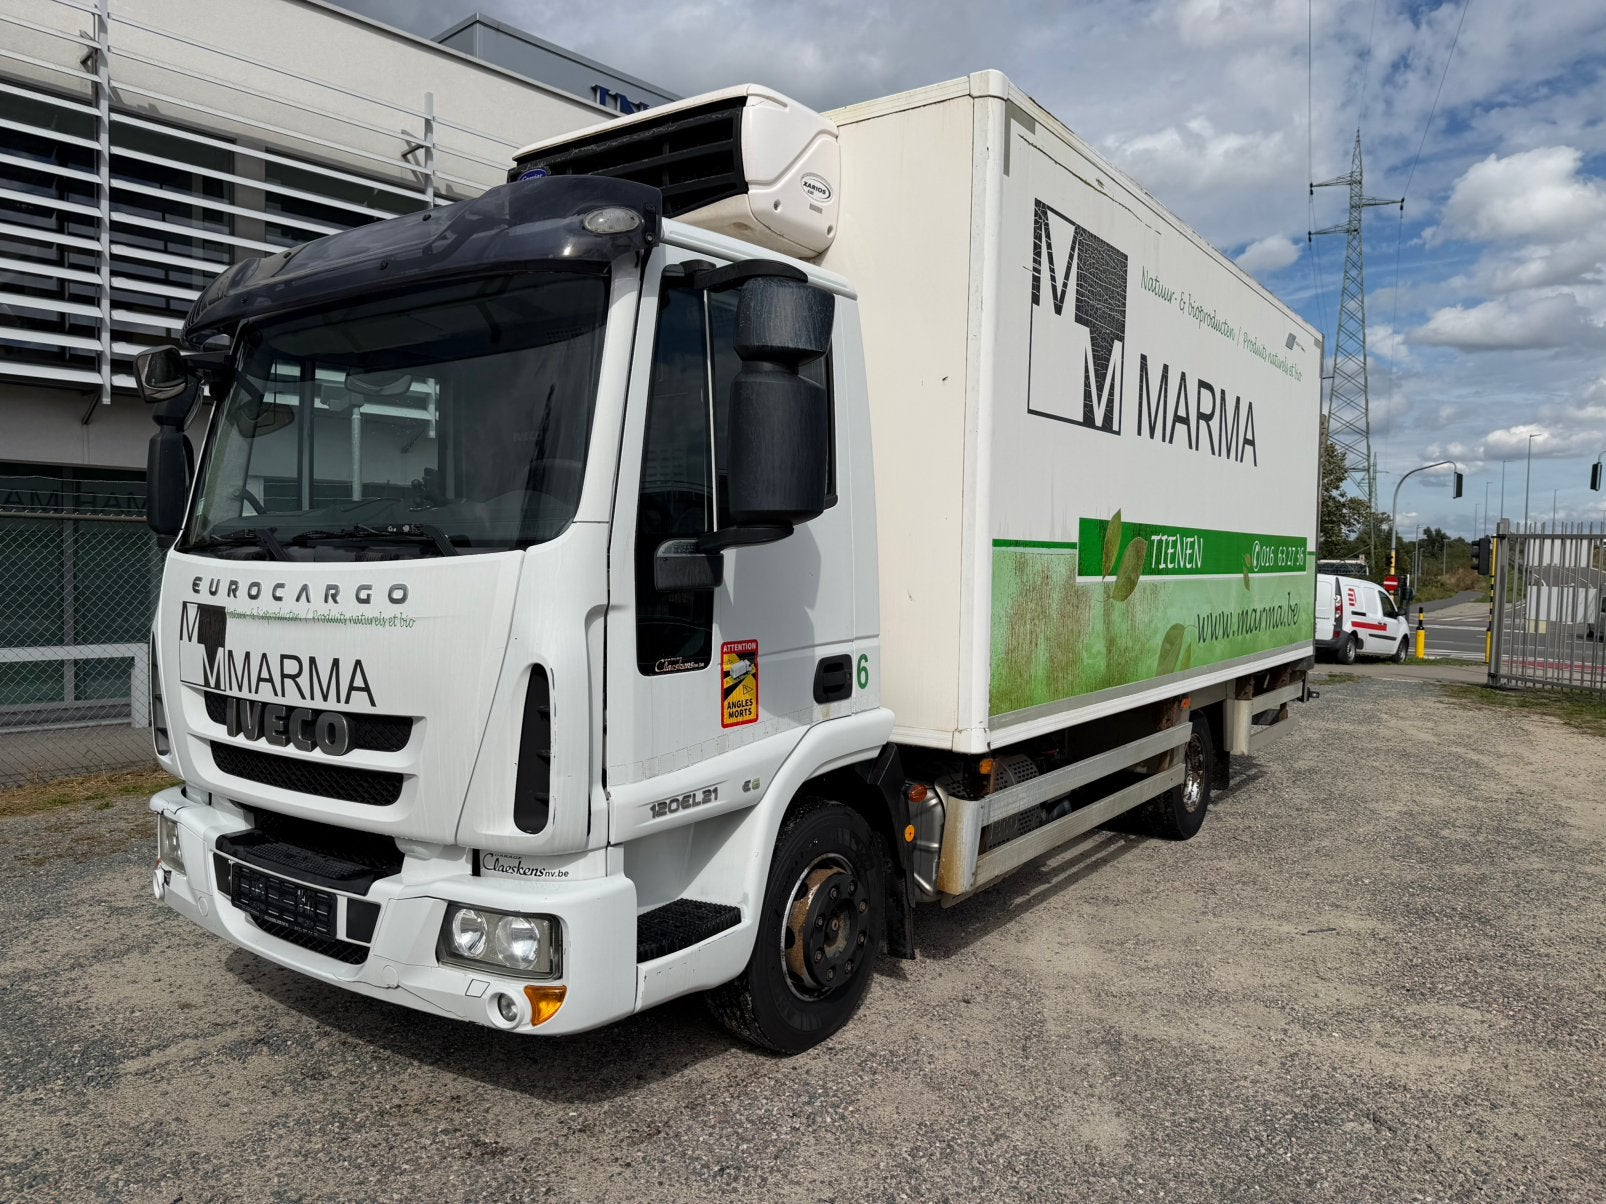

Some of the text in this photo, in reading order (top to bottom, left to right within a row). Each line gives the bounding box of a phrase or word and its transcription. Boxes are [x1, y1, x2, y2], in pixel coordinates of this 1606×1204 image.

[803, 180, 827, 195] XARIOS
[1179, 291, 1186, 315] &
[1188, 293, 1235, 340] bioproducten
[1136, 353, 1257, 467] MARMA
[1150, 533, 1203, 569] TIENEN
[1260, 545, 1274, 567] 016
[1277, 546, 1286, 567] 63
[1287, 546, 1296, 566] 27
[191, 575, 410, 605] EUROCARGO
[312, 609, 347, 626] Produits
[348, 611, 387, 628] naturels
[388, 612, 398, 627] et
[399, 612, 416, 629] bio
[1196, 591, 1300, 645] www.marma.be
[723, 641, 757, 653] ATTENTION
[227, 649, 377, 708] MARMA
[856, 653, 869, 690] 6
[726, 698, 754, 711] ANGLES
[727, 707, 753, 720] MORTS
[226, 697, 350, 757] IVECO
